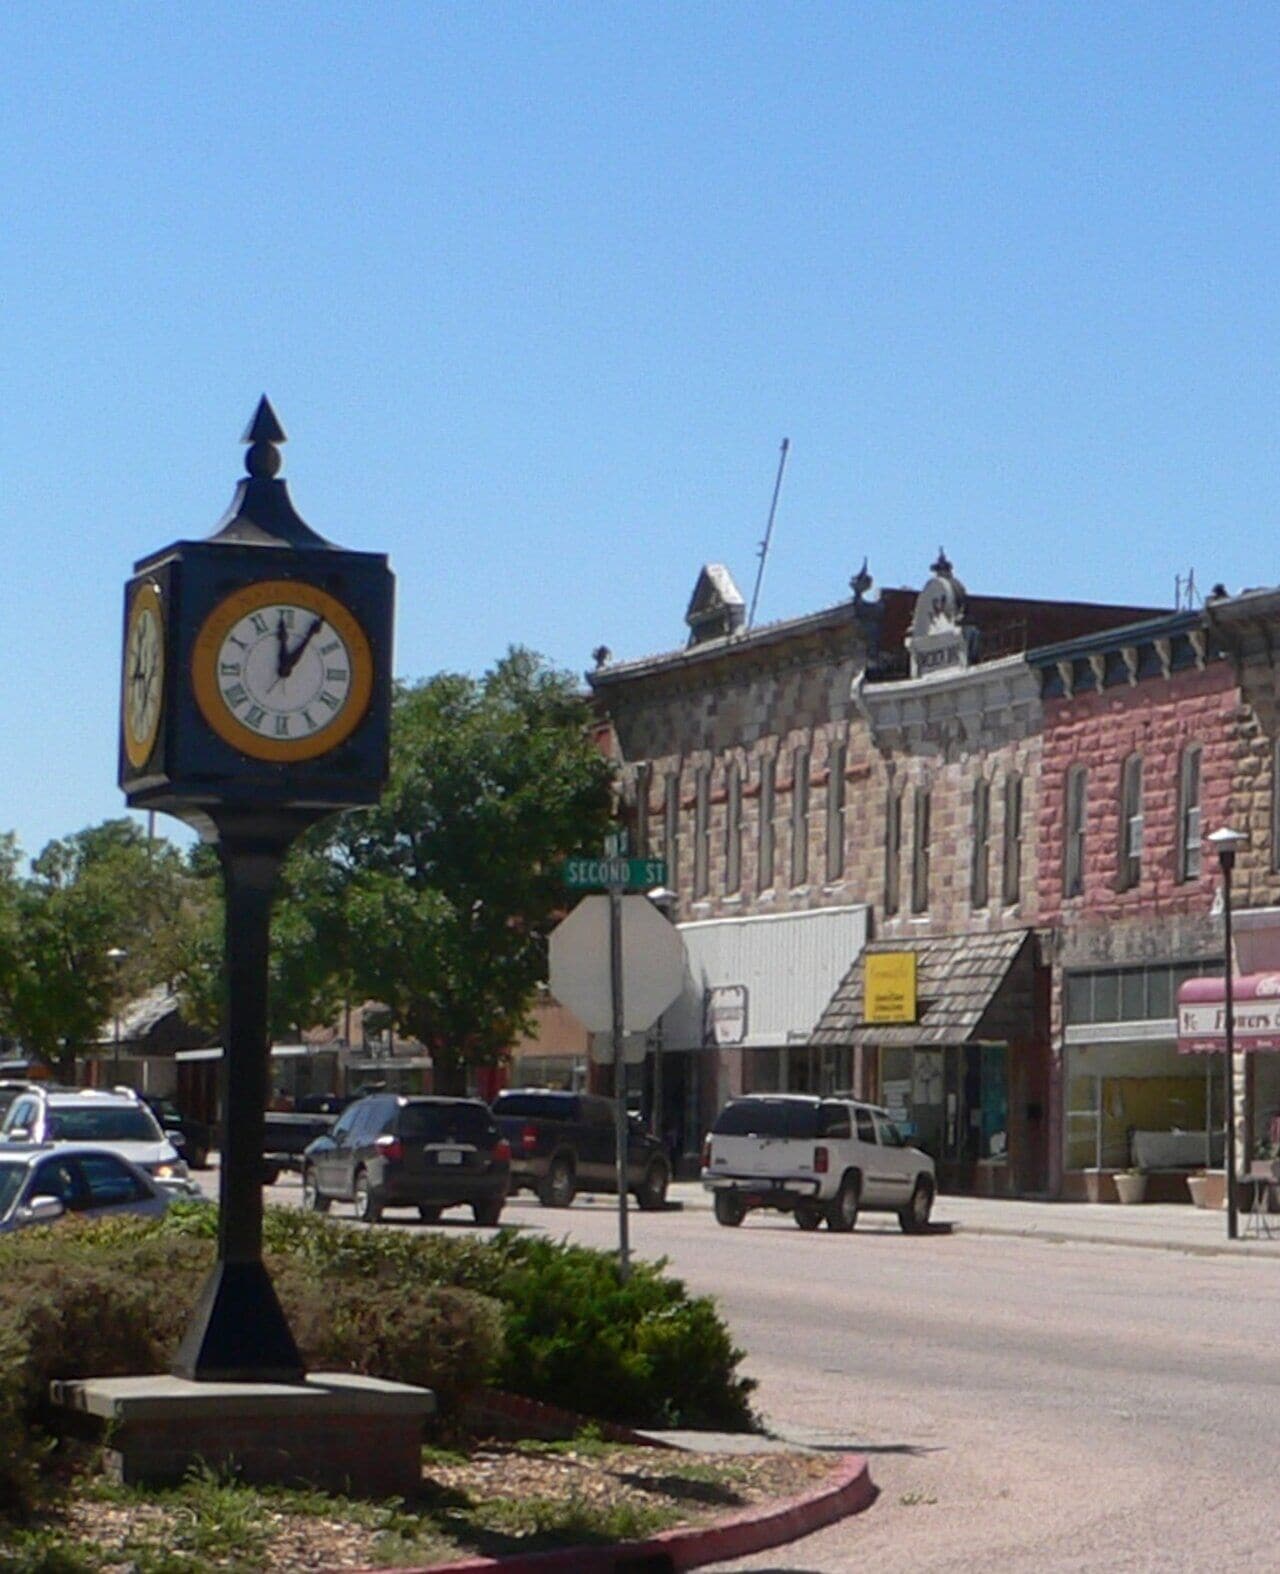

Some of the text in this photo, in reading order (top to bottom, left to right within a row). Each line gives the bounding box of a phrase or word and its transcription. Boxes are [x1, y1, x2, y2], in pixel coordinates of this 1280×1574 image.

[567, 861, 664, 884] SECOND ST
[1213, 1008, 1271, 1031] Fowers
